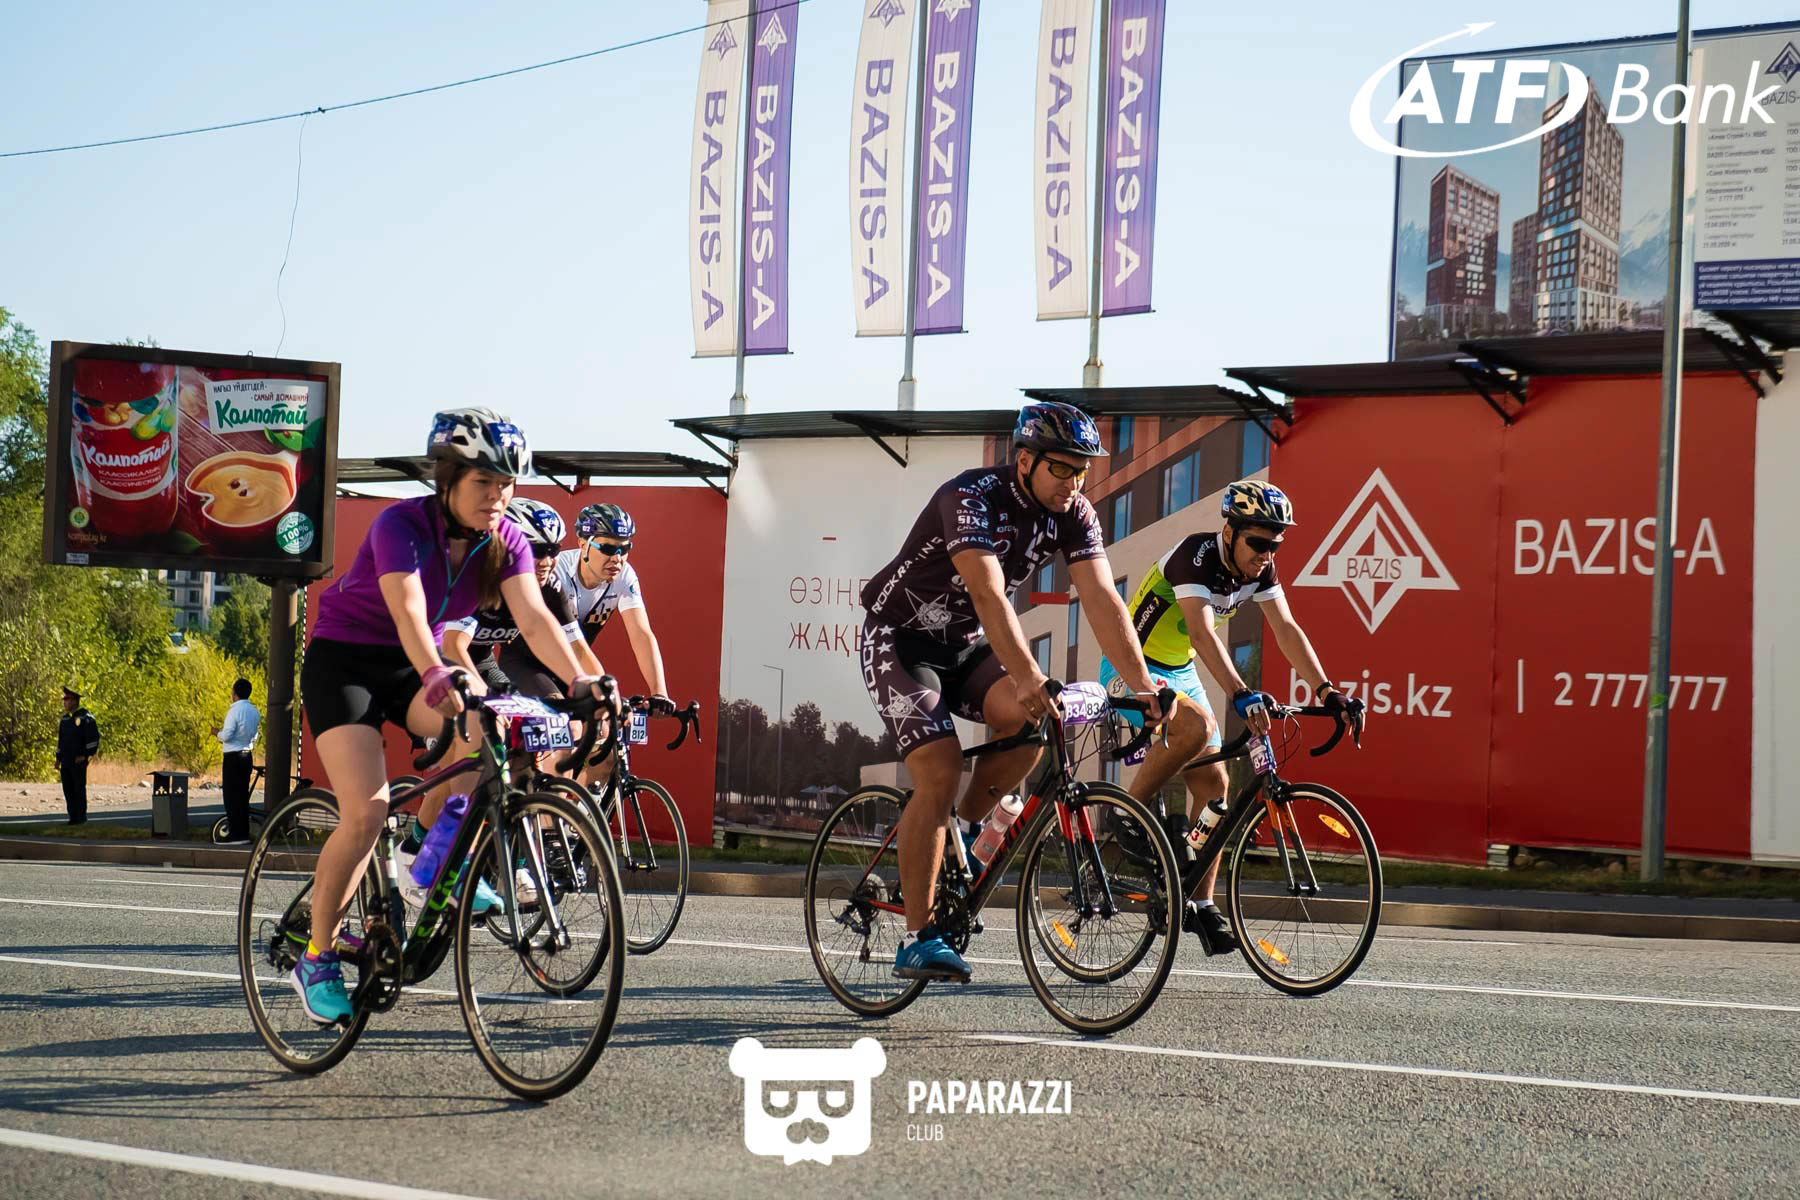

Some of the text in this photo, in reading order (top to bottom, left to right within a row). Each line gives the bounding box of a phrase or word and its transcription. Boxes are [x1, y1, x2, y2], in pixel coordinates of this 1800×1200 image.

[1045, 27, 1077, 292] BAZIS-A
[1114, 17, 1148, 288] BAZIS-A
[859, 59, 894, 310] BAZIS-A
[927, 51, 960, 309] BAZIS-A
[700, 90, 727, 332] BAZIS-A
[751, 83, 779, 331] BAZIS-A
[254, 392, 274, 402] САМЫЙ
[1347, 557, 1402, 580] BAZIS
[1514, 517, 1725, 576] BAZIS-A
[476, 627, 520, 640] BOR
[1289, 667, 1453, 718] bzis.kz
[1554, 672, 1574, 706] 2
[1585, 673, 1649, 708] 777
[527, 733, 548, 747] 156
[551, 732, 569, 745] 156
[631, 729, 645, 740] 812
